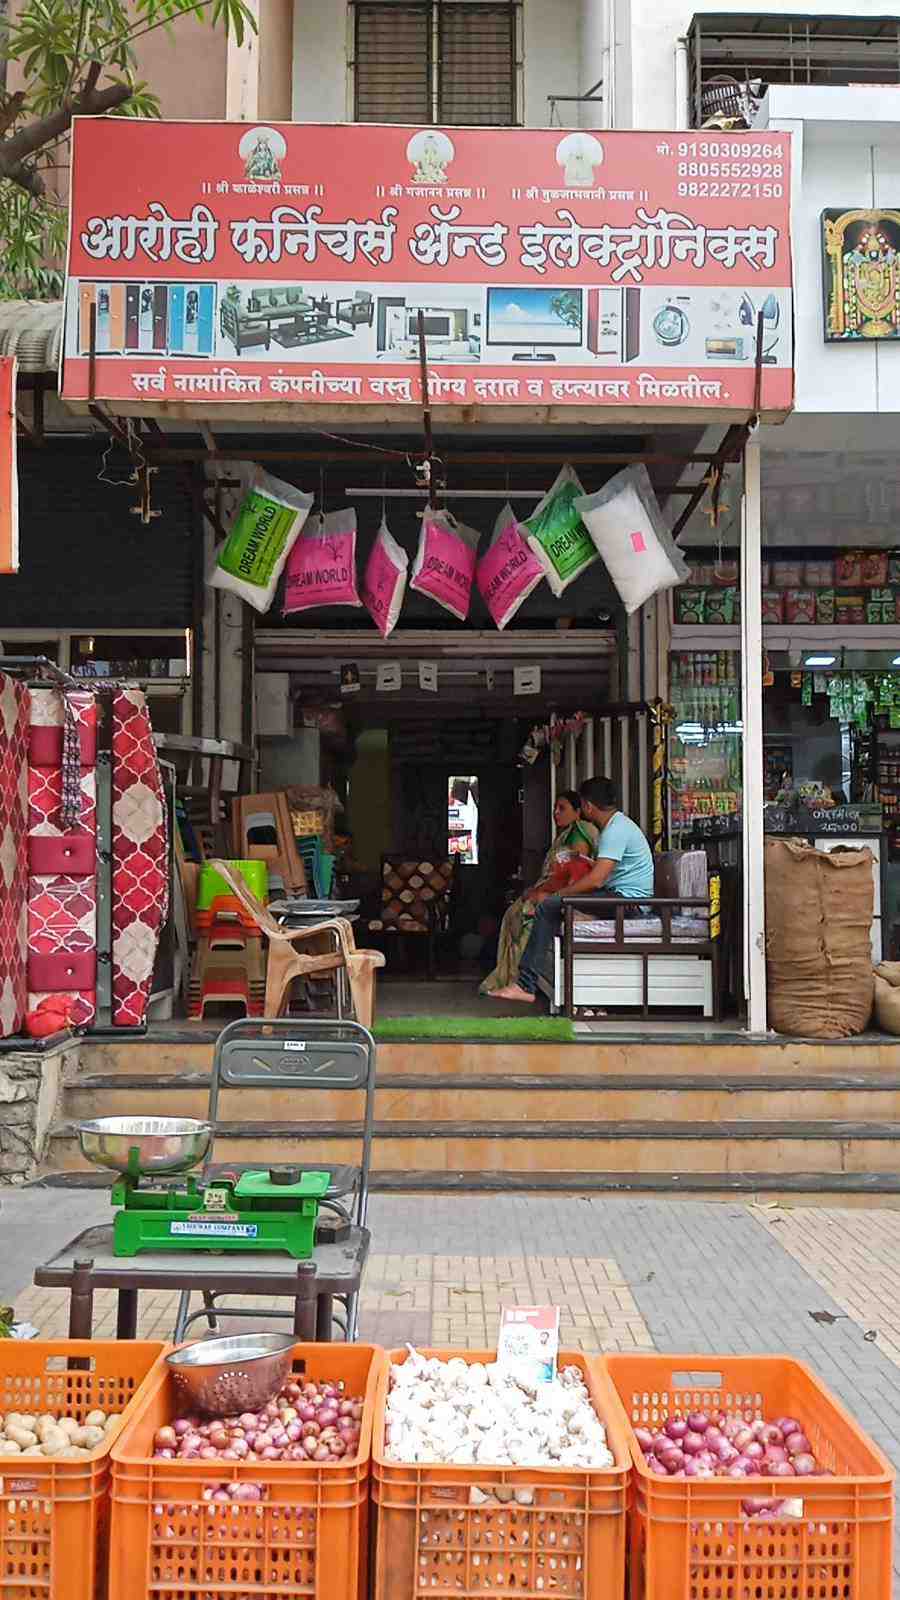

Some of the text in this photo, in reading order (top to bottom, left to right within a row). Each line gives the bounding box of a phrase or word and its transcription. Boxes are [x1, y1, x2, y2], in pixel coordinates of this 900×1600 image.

[678, 142, 783, 158] 9130309264
[678, 162, 783, 178] 8805552928
[405, 187, 443, 198] गजानन
[678, 182, 783, 198] 9822272150
[80, 202, 219, 263] आरोही
[229, 204, 399, 266] फर्निचर्स
[131, 366, 166, 392] सर्व
[172, 368, 262, 393] नामांकित
[268, 369, 362, 395] कंपनीच्या
[473, 378, 520, 398] दरात
[526, 379, 544, 397] व
[636, 372, 730, 399] मिळतील.
[238, 538, 257, 574] DREAM
[250, 505, 276, 540] WORLD
[549, 529, 577, 557] DREAM
[313, 567, 347, 583] WORLD
[497, 550, 527, 579] WORLD
